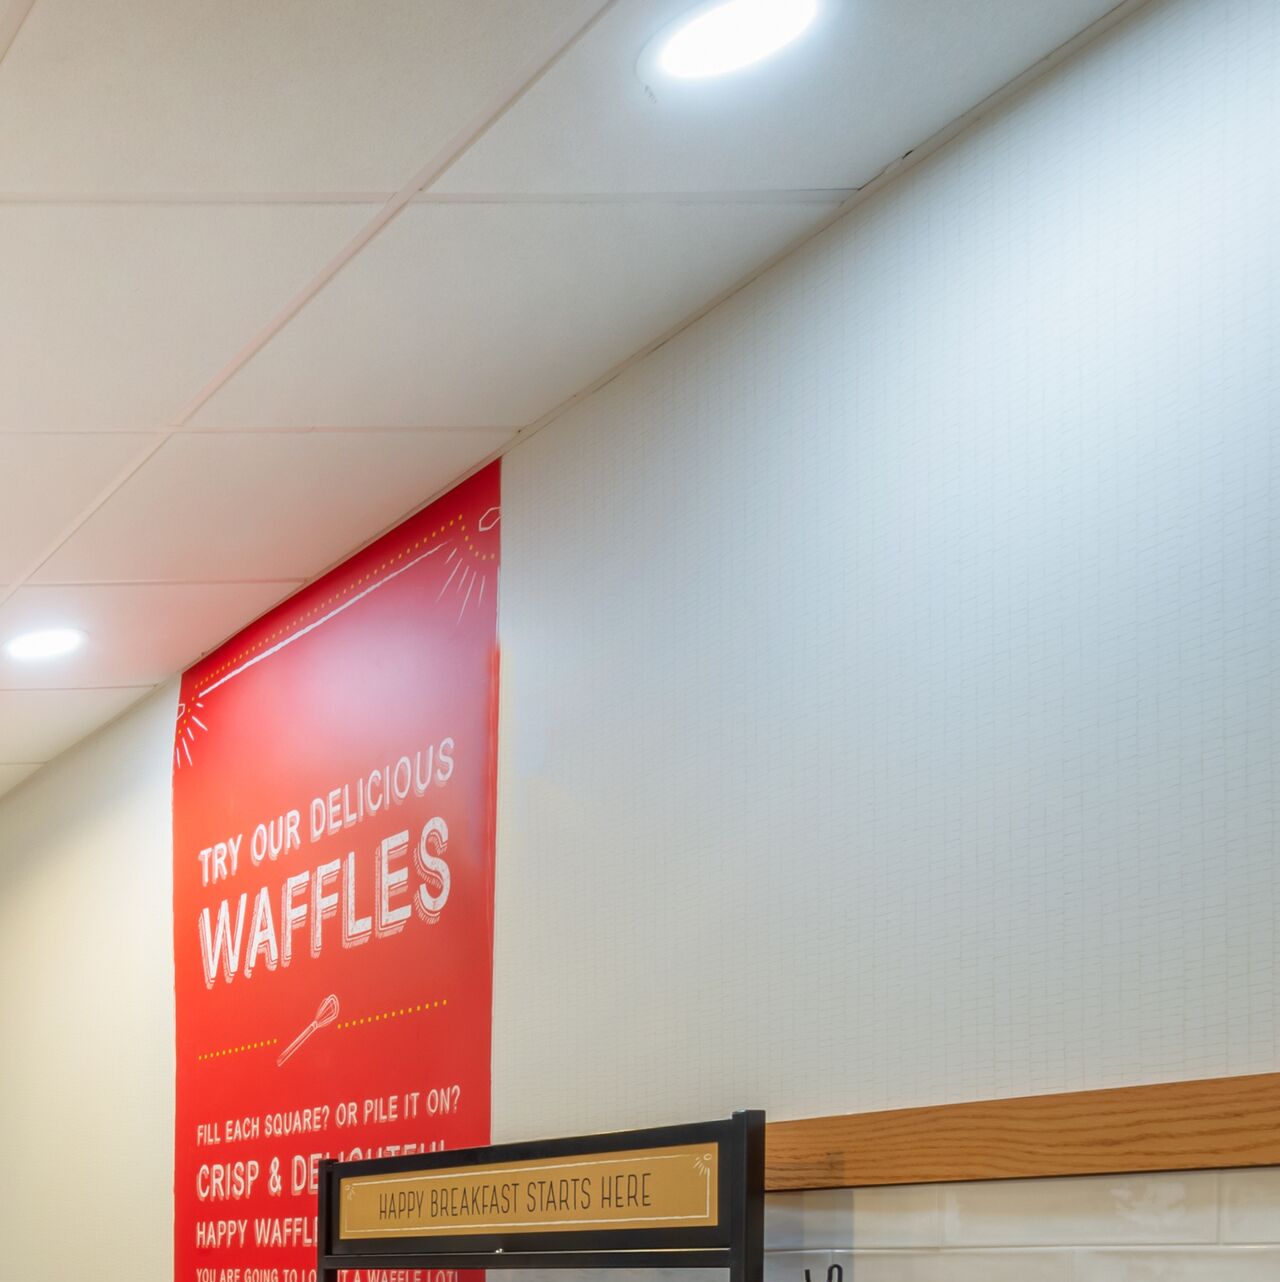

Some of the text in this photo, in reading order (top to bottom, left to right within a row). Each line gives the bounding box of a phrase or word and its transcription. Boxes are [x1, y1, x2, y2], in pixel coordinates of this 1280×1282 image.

[198, 736, 455, 886] TRY OUR DELICIOUS
[198, 816, 451, 990] WAFFLES
[197, 1085, 460, 1147] FILL EACH SQUARE? OR PILE IT ON?
[197, 1160, 260, 1201] CRISP
[268, 1156, 283, 1196] &
[379, 1172, 652, 1221] HAPPY BREAKFAST STARTS HERE
[197, 1217, 318, 1248] HAPPY WAFFL
